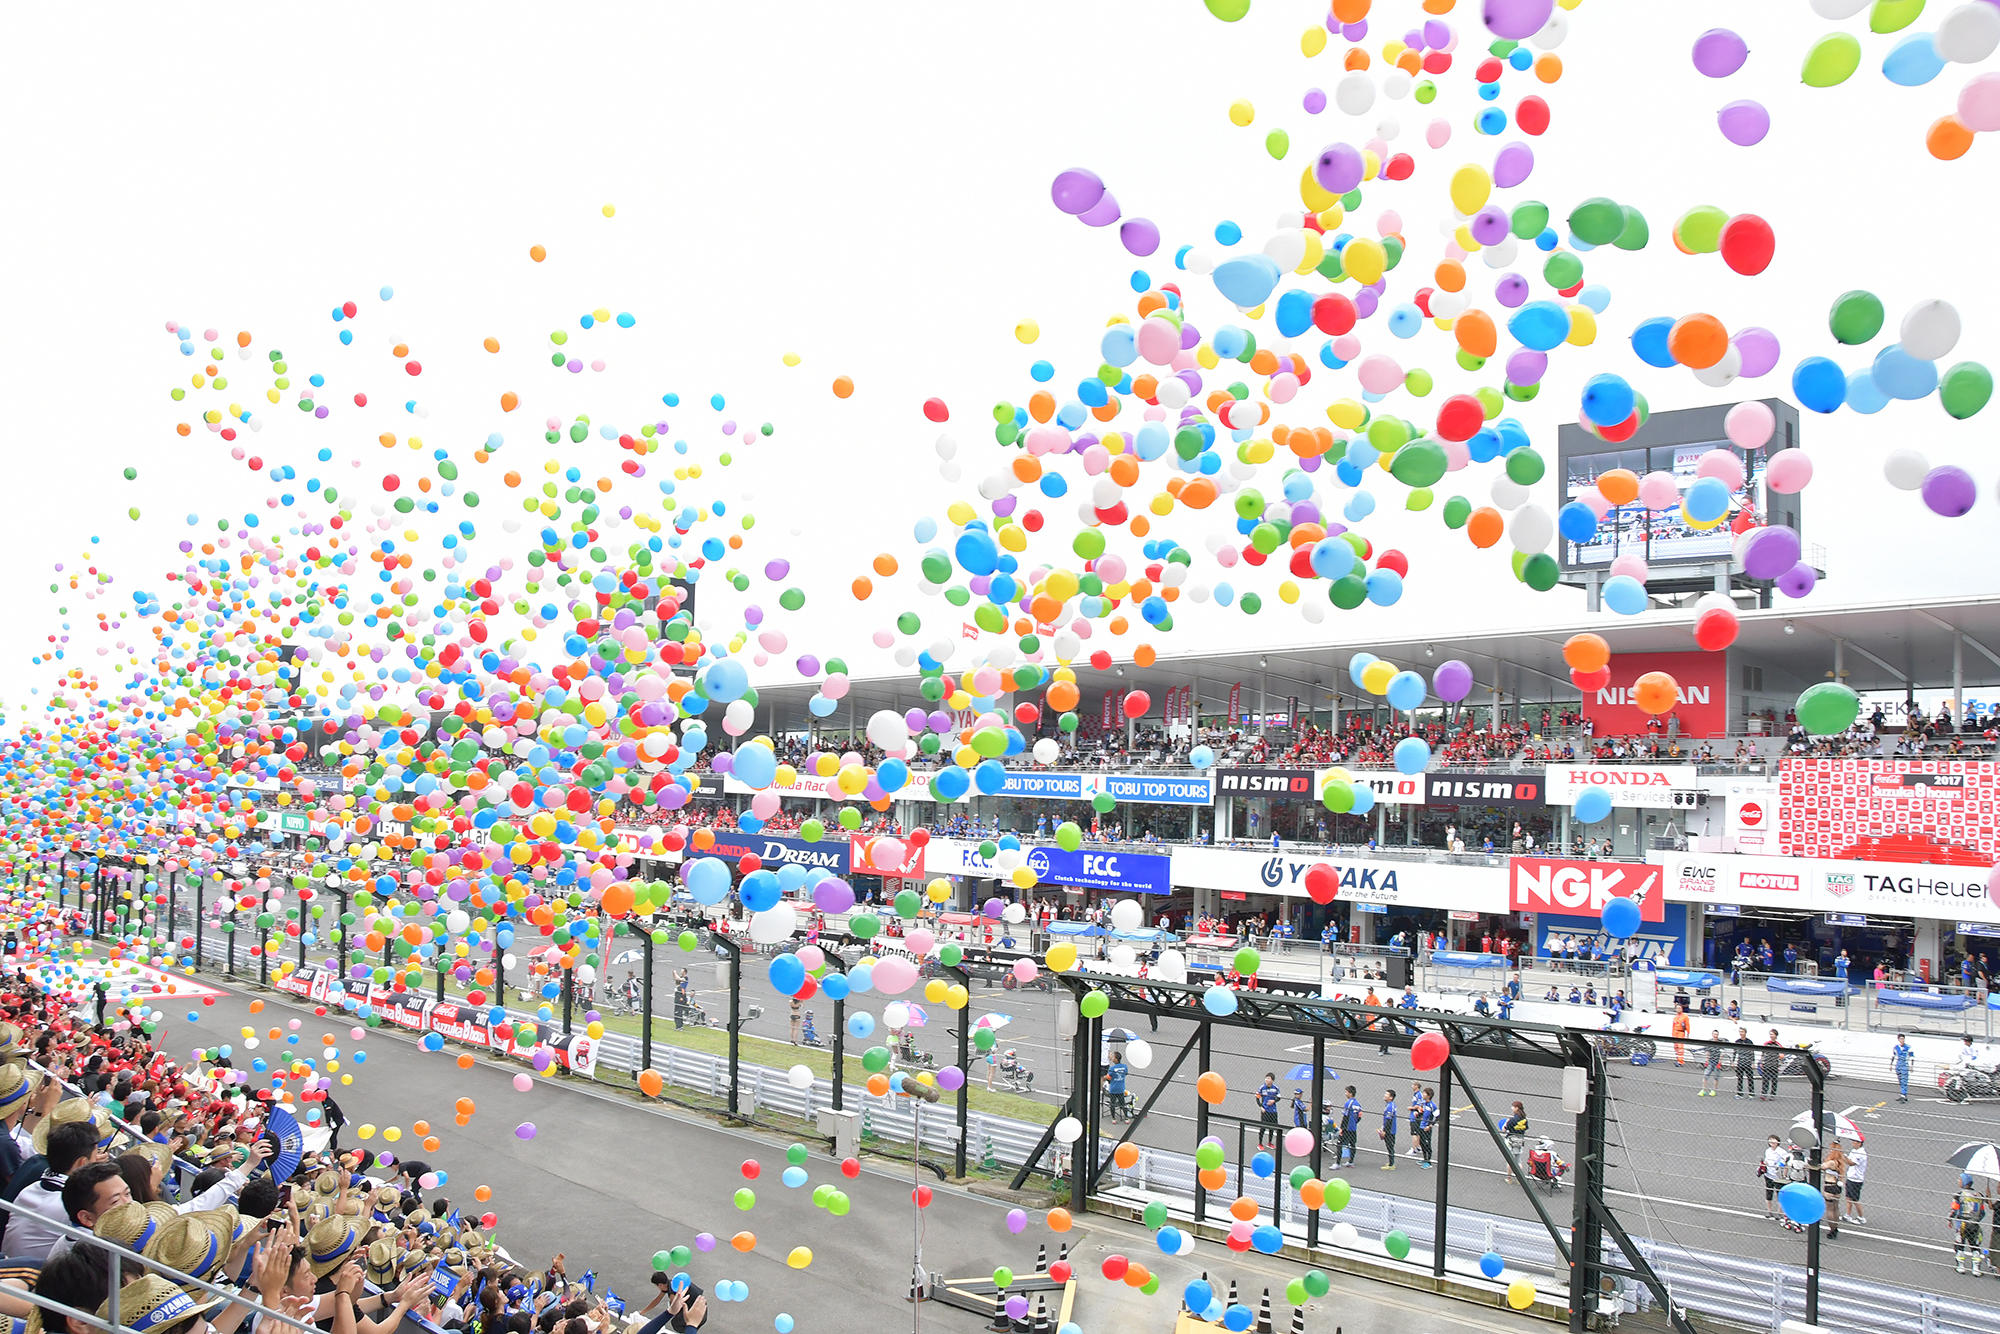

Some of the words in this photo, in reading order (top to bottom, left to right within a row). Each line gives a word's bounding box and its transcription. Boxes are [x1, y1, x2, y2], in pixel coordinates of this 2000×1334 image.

[1596, 685, 1710, 704] NIAN
[1023, 779, 1044, 791] TOP
[1045, 779, 1080, 792] TOURS
[1569, 771, 1672, 786] HONDA
[1934, 776, 1962, 785] 2017
[1109, 781, 1140, 796] TOBU
[1142, 783, 1166, 796] TOP
[1168, 783, 1208, 798] TOURS
[1289, 863, 1398, 891] YAKA
[1682, 867, 1716, 878] EWC
[1517, 864, 1626, 911] NGK
[1741, 873, 1797, 890] MOTUL
